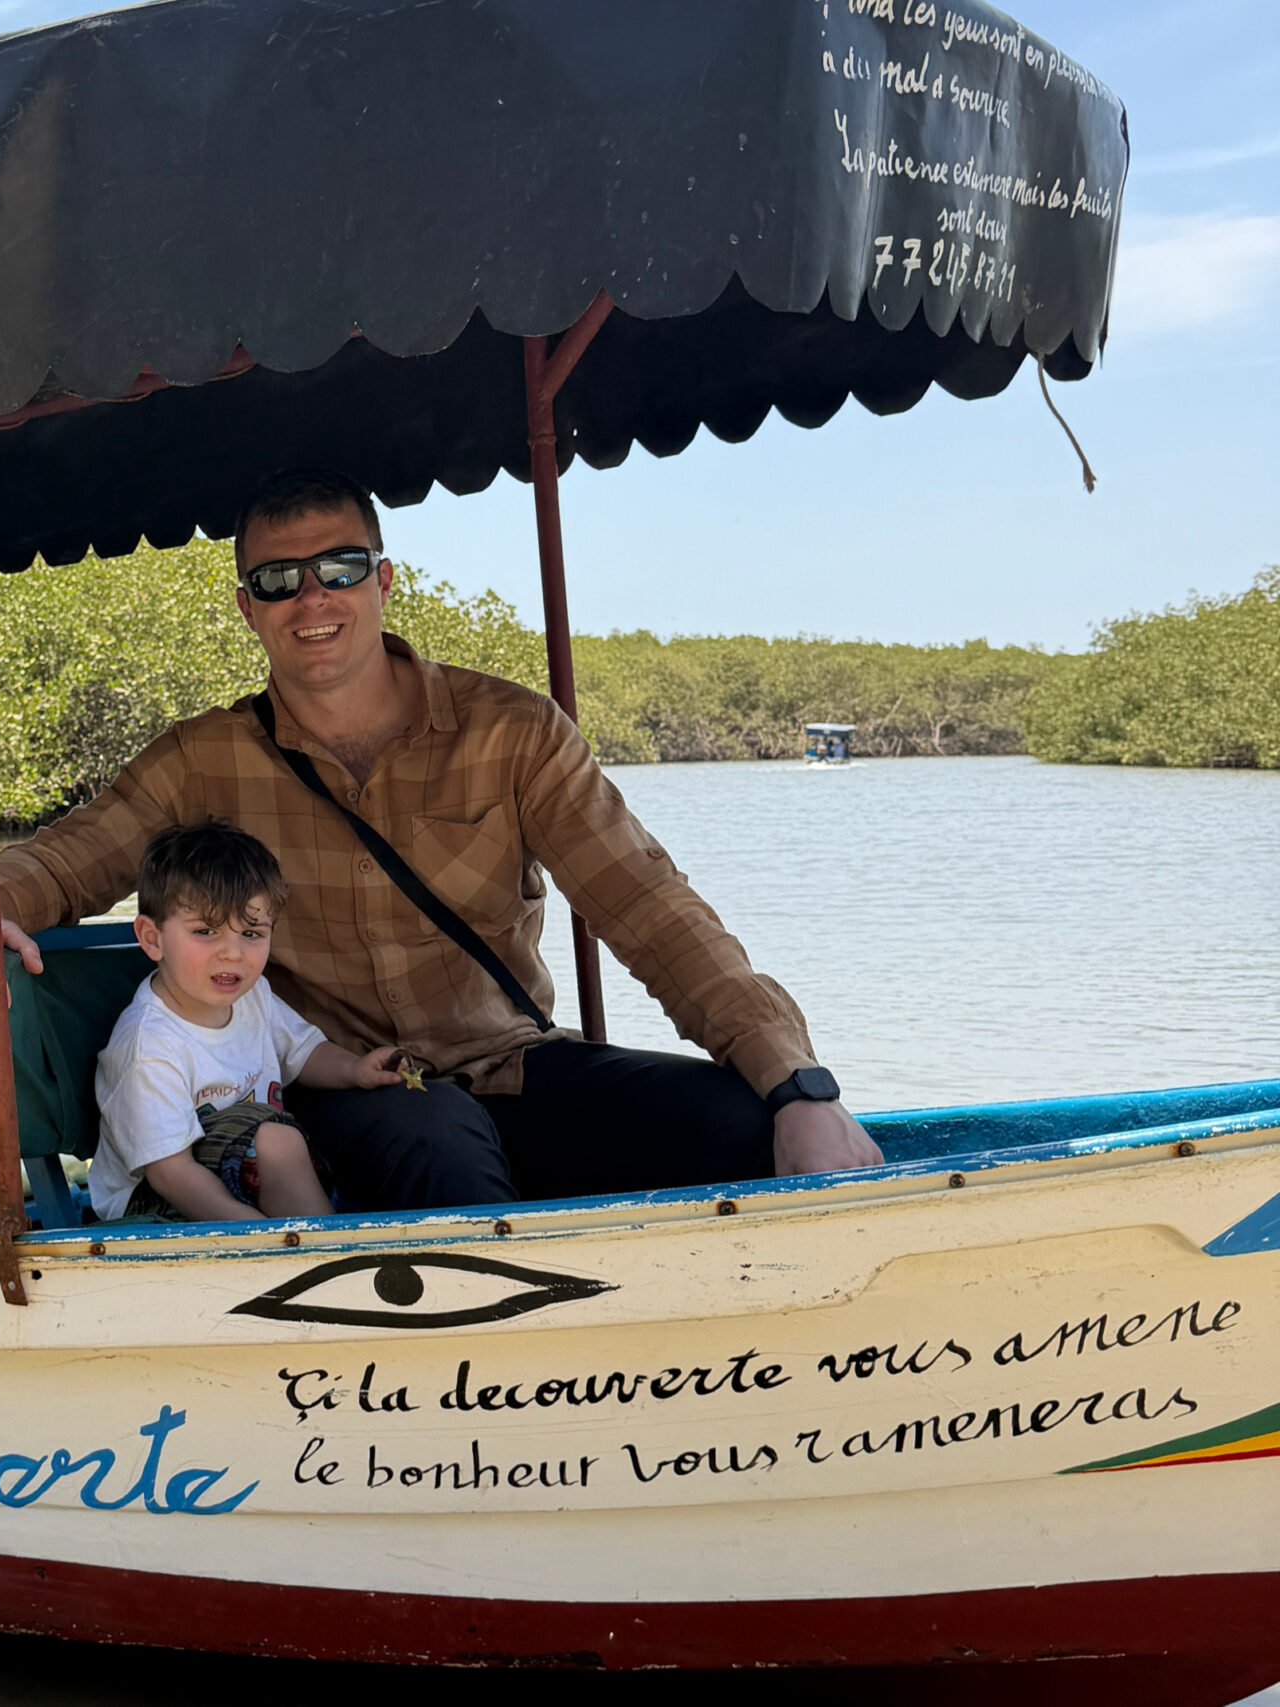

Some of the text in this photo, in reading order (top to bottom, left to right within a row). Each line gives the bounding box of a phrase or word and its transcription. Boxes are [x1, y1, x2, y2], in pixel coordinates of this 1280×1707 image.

[942, 10, 989, 51] yeux
[990, 24, 1025, 62] sont
[1025, 44, 1044, 70] en
[866, 138, 948, 190] patience
[1047, 177, 1069, 209] les
[937, 200, 974, 235] sont
[358, 1360, 422, 1413] la
[438, 1346, 793, 1412] decouverte
[817, 1338, 973, 1383] vous
[993, 1299, 1242, 1366] amene
[293, 1436, 345, 1486] le
[366, 1439, 600, 1489] bonheur
[794, 1386, 1199, 1464] rameneras
